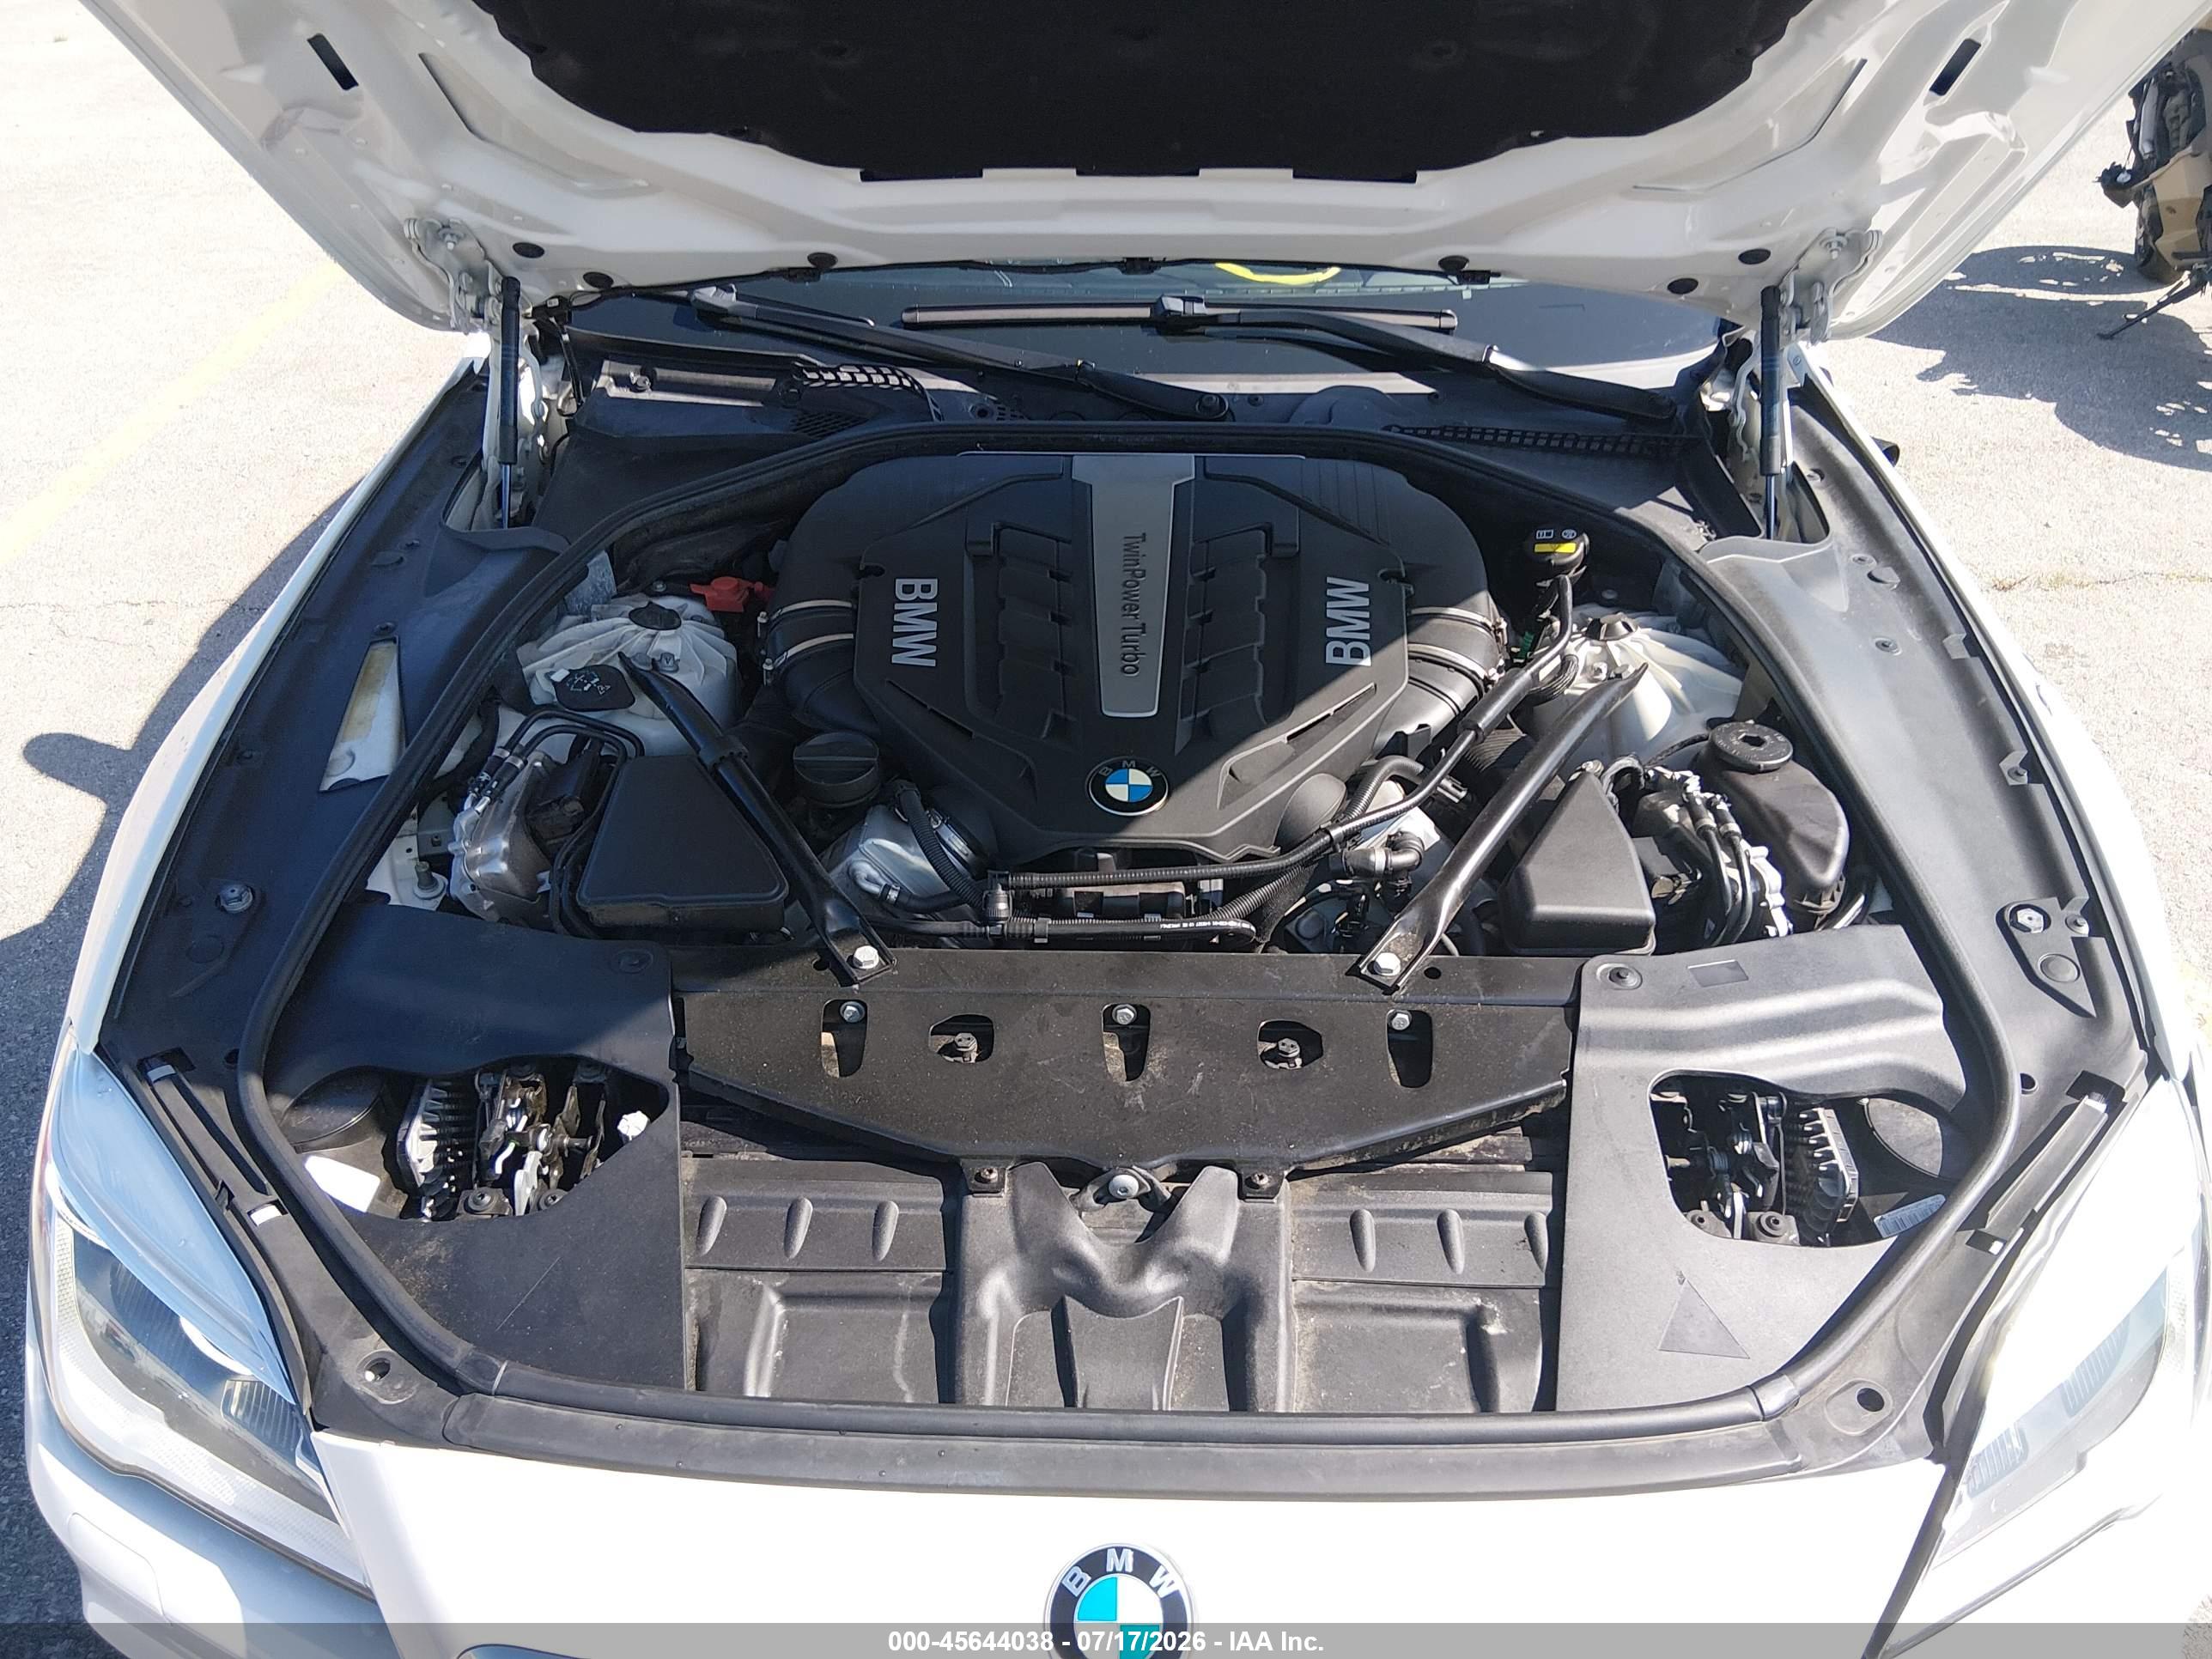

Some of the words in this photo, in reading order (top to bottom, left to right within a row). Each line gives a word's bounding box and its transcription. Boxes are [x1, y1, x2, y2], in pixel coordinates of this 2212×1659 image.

[891, 578, 939, 667] BMW
[1325, 576, 1372, 667] BMW
[1099, 760, 1162, 777] BMW
[1061, 1547, 1181, 1598] BMW
